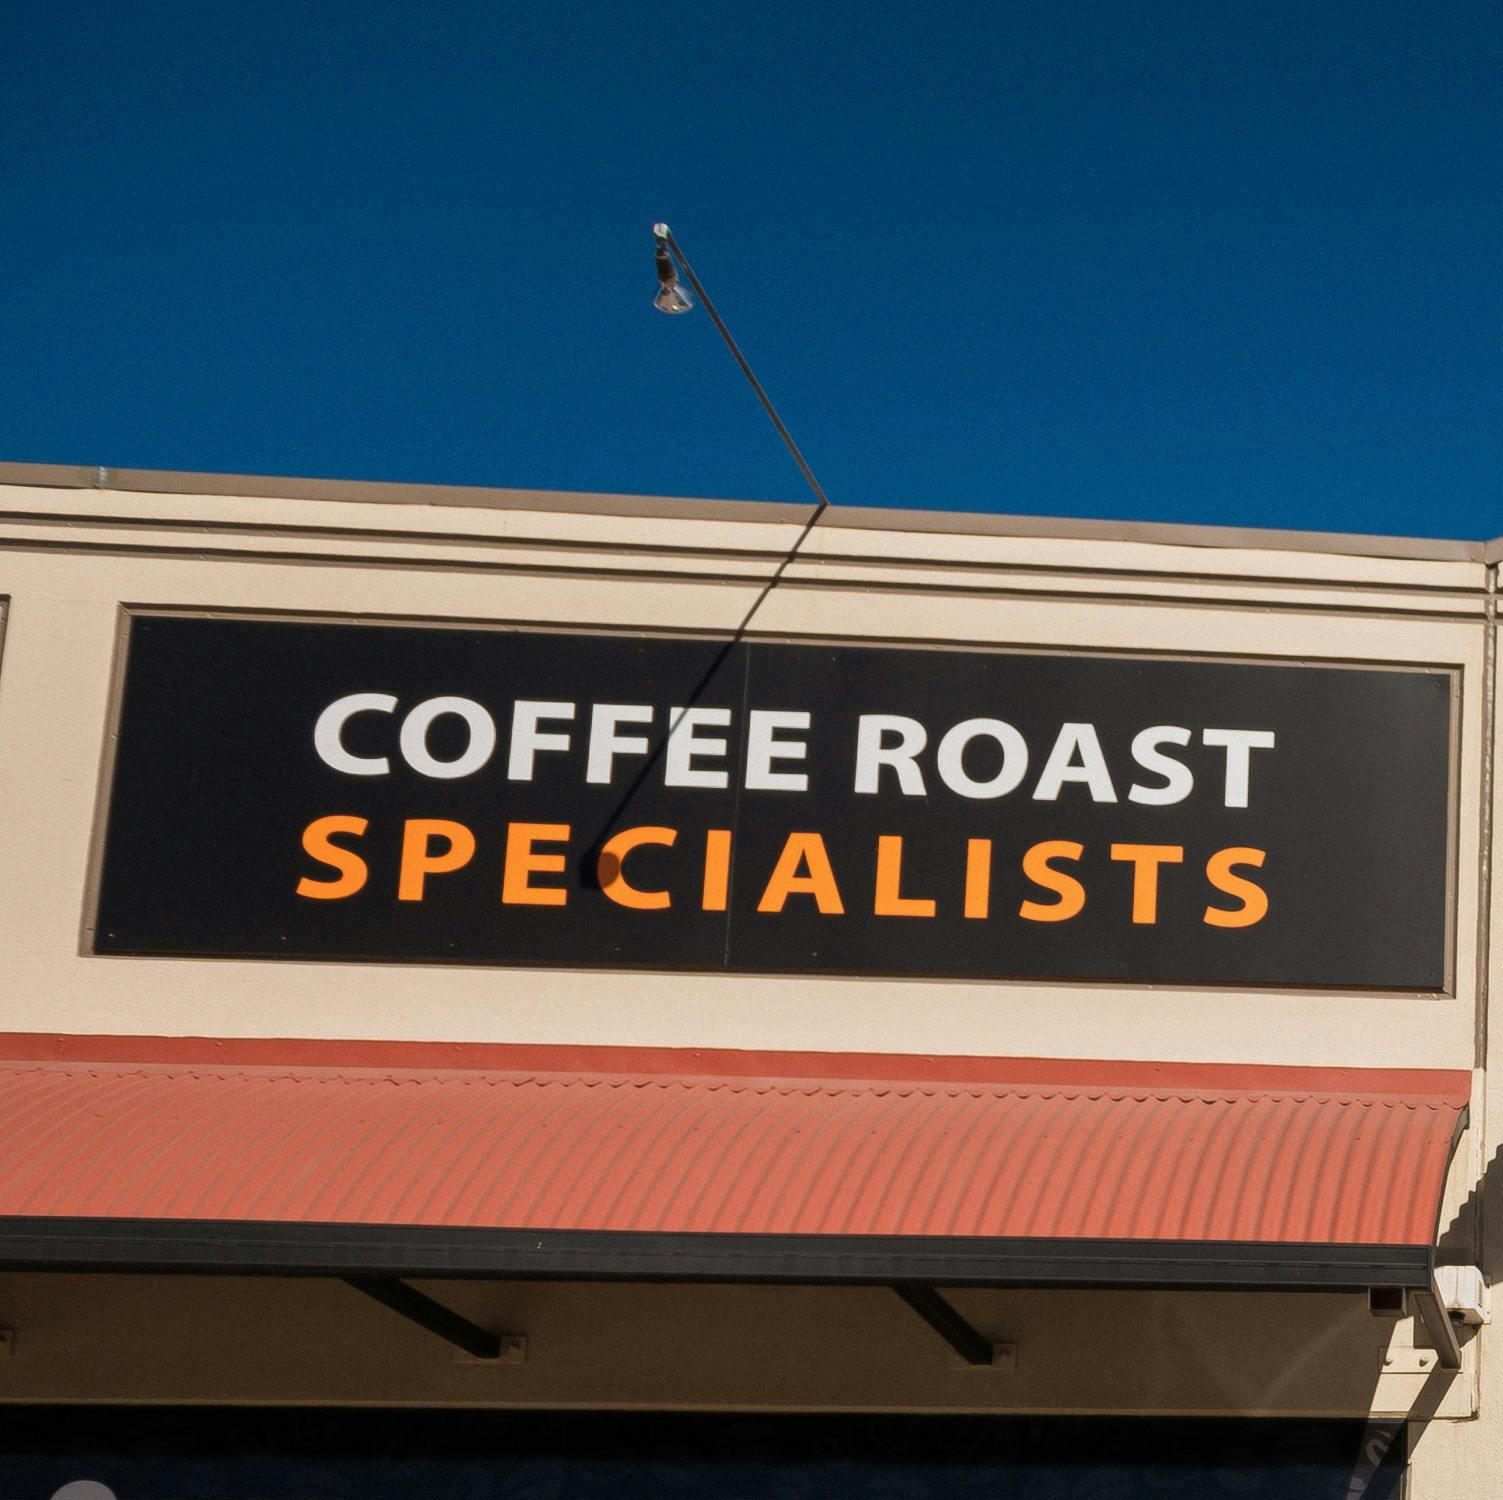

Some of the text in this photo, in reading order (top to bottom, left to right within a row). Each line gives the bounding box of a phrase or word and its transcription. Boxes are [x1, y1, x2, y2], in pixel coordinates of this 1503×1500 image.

[313, 691, 1276, 809] COFFEE ROAST
[294, 814, 1270, 930] SPECIALISTS
